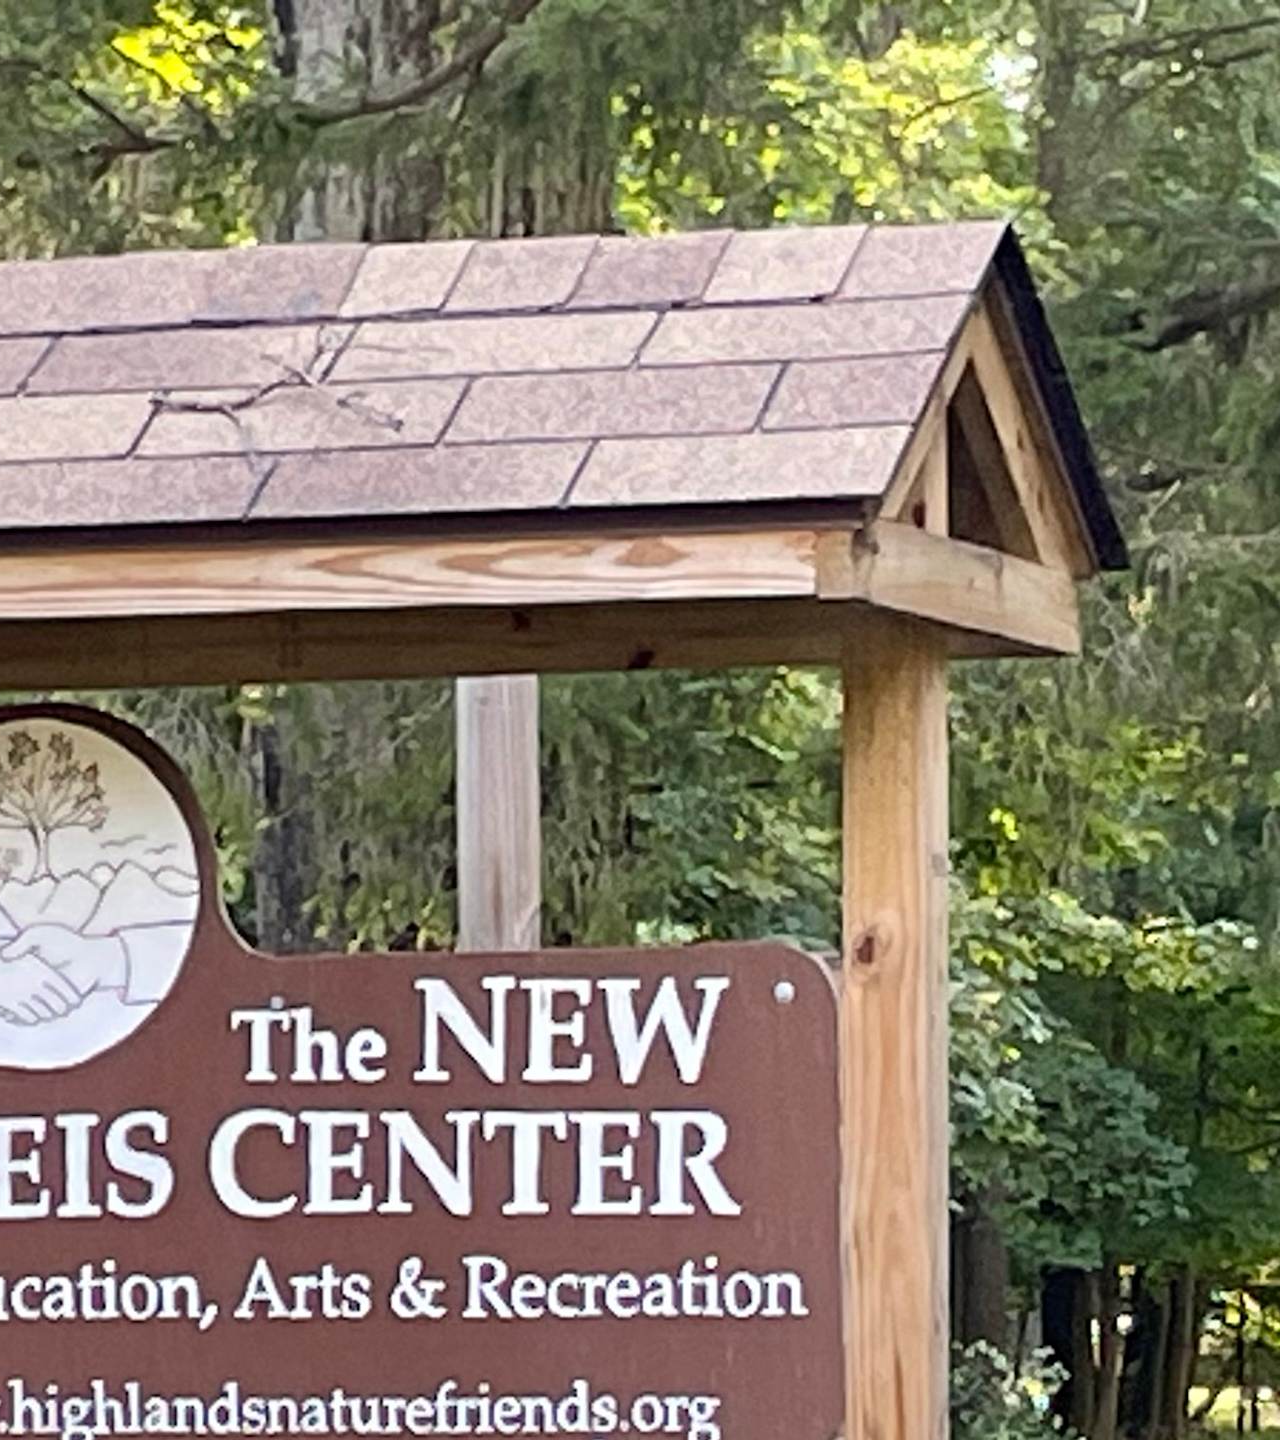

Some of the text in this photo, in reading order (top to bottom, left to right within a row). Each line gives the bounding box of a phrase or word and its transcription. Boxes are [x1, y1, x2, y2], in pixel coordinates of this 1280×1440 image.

[231, 976, 730, 1084] The NEW
[210, 1109, 741, 1217] CENTER
[234, 1258, 371, 1319] Arts
[391, 1257, 447, 1318] &
[462, 1256, 809, 1318] Recreation
